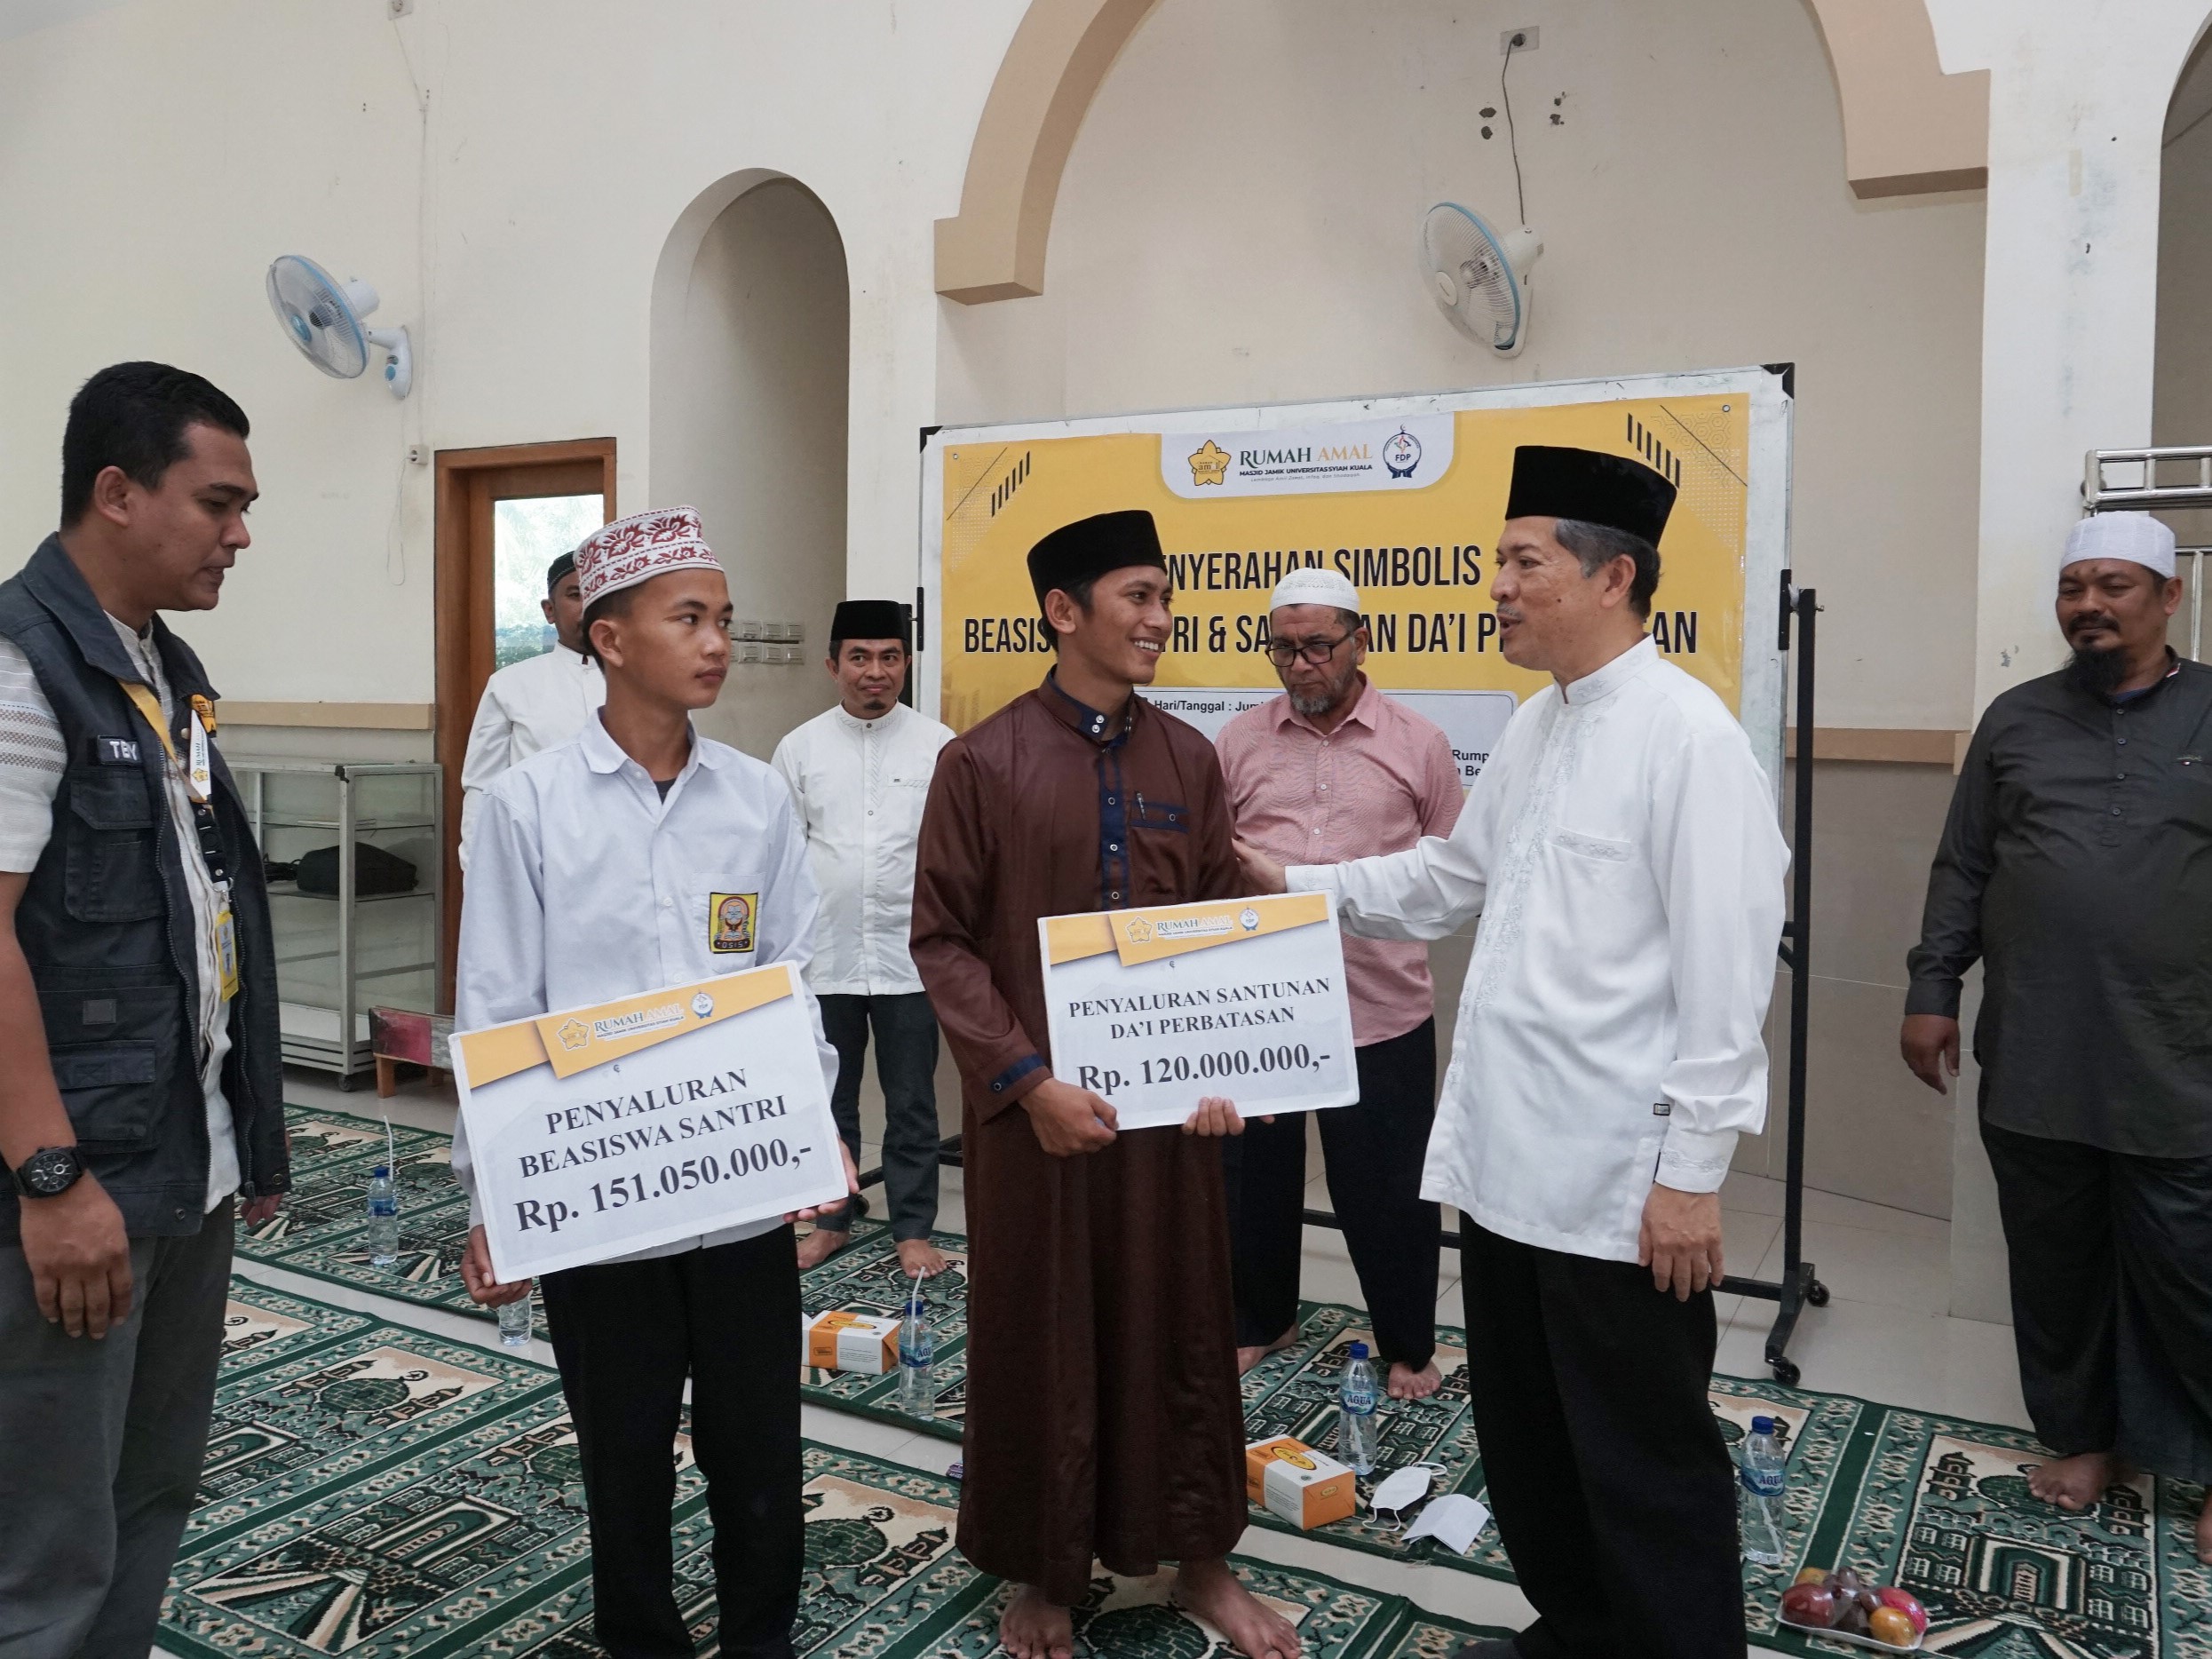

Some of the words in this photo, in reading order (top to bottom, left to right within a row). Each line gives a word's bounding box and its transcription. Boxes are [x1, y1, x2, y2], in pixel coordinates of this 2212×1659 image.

[1240, 447, 1312, 469] RUMAH
[1317, 443, 1373, 462] AMAL
[1395, 453, 1411, 462] FDP
[1162, 550, 1323, 591] NYERAHAN
[1334, 544, 1482, 587] SIMBOLIS
[1209, 615, 1226, 653] &
[1154, 700, 1225, 713] Hari/Tanggal
[1452, 750, 1489, 764] Rump
[1157, 919, 1198, 932] RUMAH
[1201, 916, 1233, 926] AMAL
[1068, 988, 1211, 1018] PENYALURAN
[1217, 978, 1330, 1004] SANTUNAN
[595, 1012, 643, 1032] RUMAH
[646, 1004, 683, 1018] AMAL
[1160, 1006, 1296, 1035] PERBATASAN
[1077, 1065, 1130, 1096] Rp.
[1140, 1043, 1331, 1084] 120.000.000,-
[544, 1068, 749, 1135] PENYALURAN
[519, 1124, 675, 1179] BEASISWA
[678, 1094, 789, 1139] SANTRI
[514, 1199, 579, 1233] Rp.
[589, 1138, 813, 1214] 151.050.000,-
[1346, 1394, 1371, 1406] AQUA
